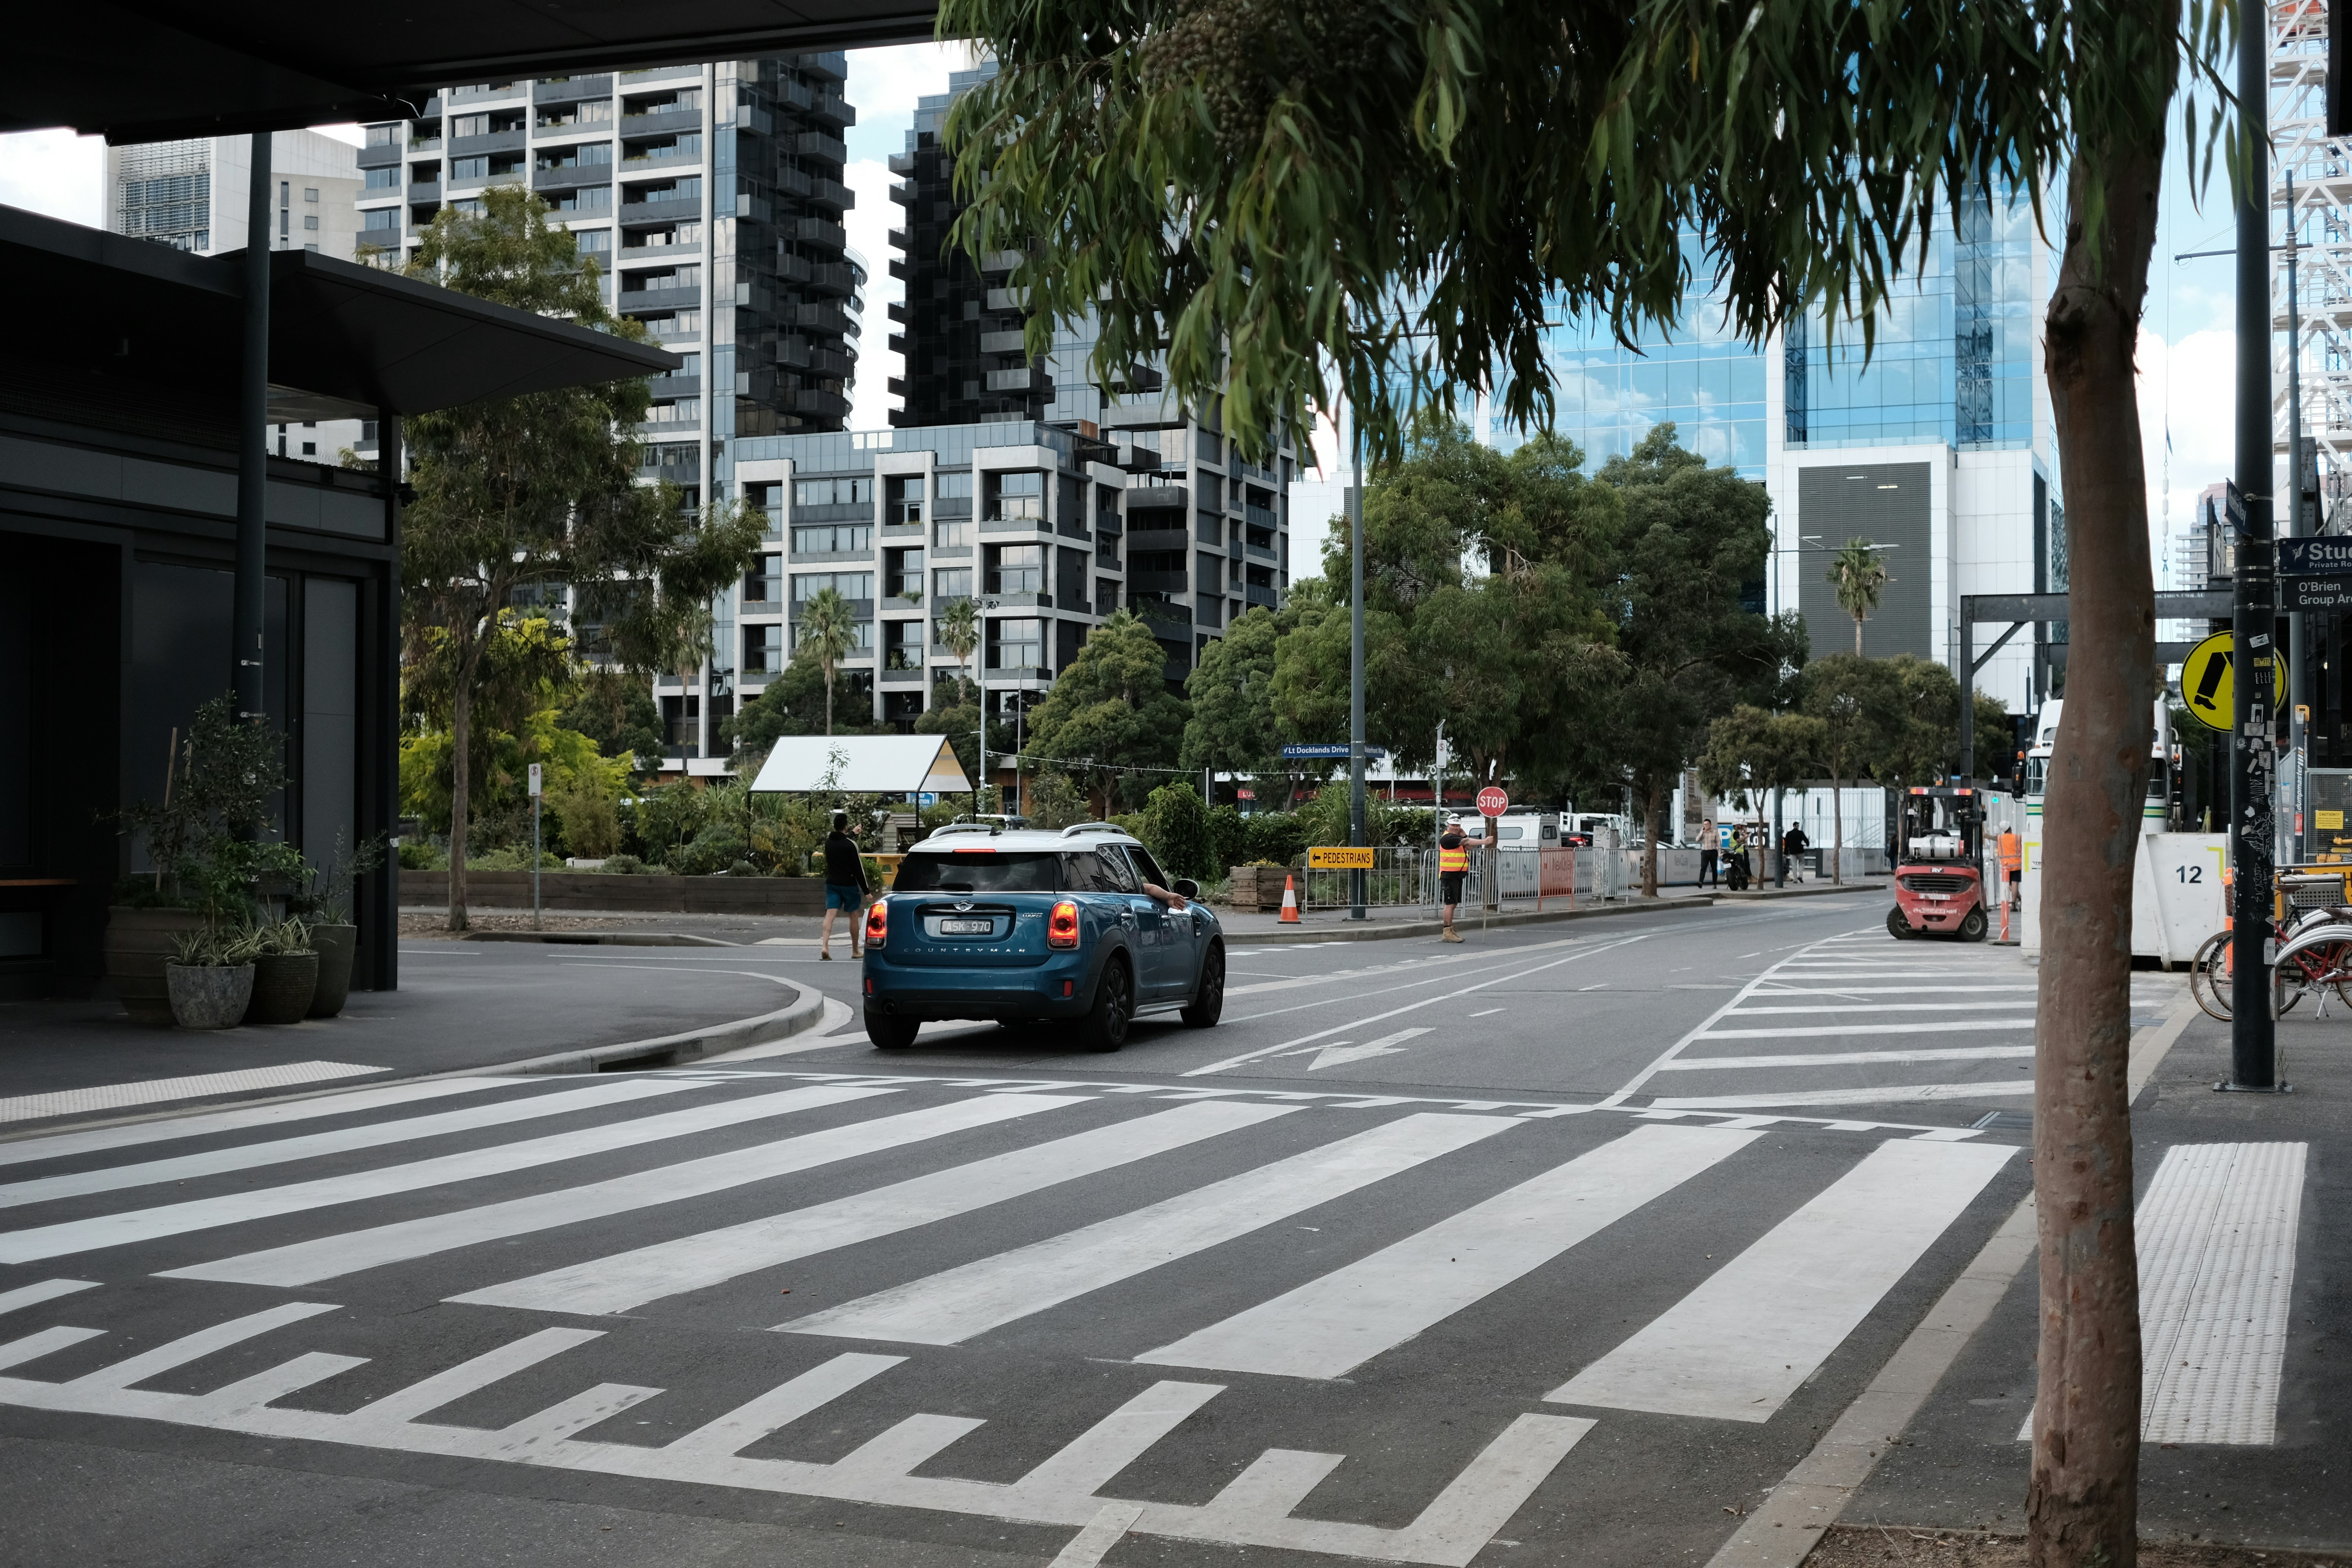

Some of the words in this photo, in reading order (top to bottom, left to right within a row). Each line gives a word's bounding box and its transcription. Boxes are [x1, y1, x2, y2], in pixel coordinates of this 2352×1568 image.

[2299, 595, 2334, 606] Group
[2337, 593, 2352, 603] Ar
[1479, 796, 1505, 808] STOP
[1323, 852, 1370, 864] PEDESTRIANS
[2176, 865, 2202, 884] 12
